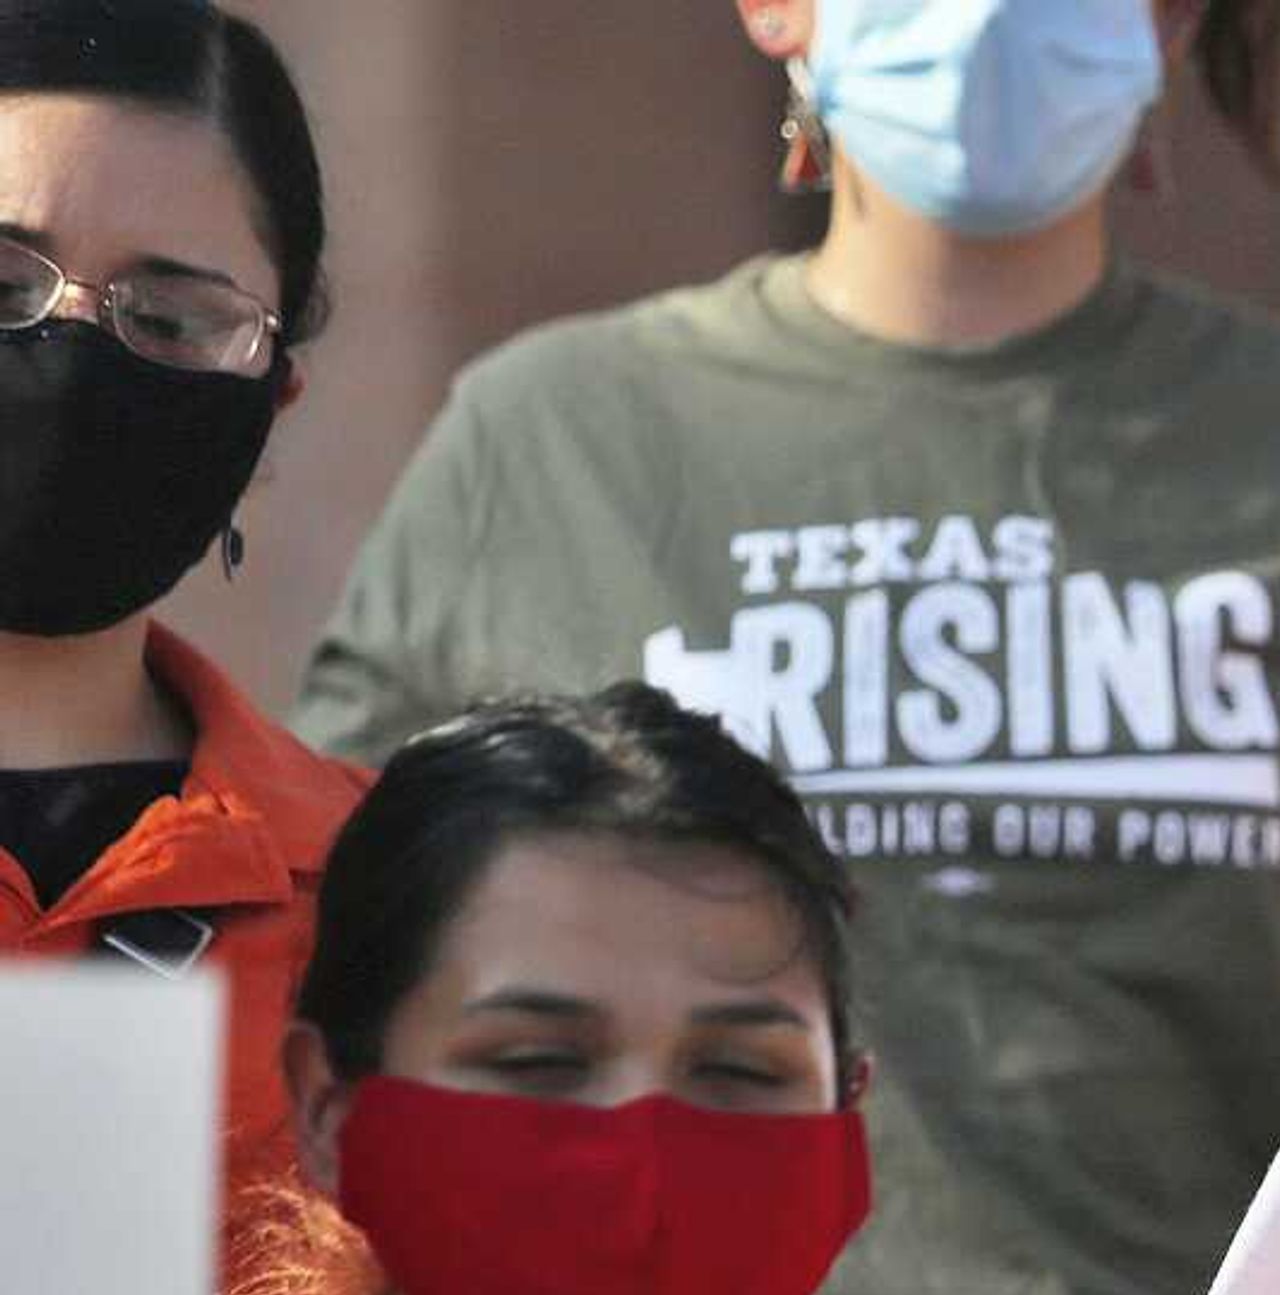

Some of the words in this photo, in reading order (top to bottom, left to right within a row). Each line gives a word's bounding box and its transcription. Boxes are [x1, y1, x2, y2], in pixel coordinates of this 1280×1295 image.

[729, 513, 1057, 594] TEXAS
[800, 802, 970, 857] LDING
[993, 802, 1097, 858] OUR
